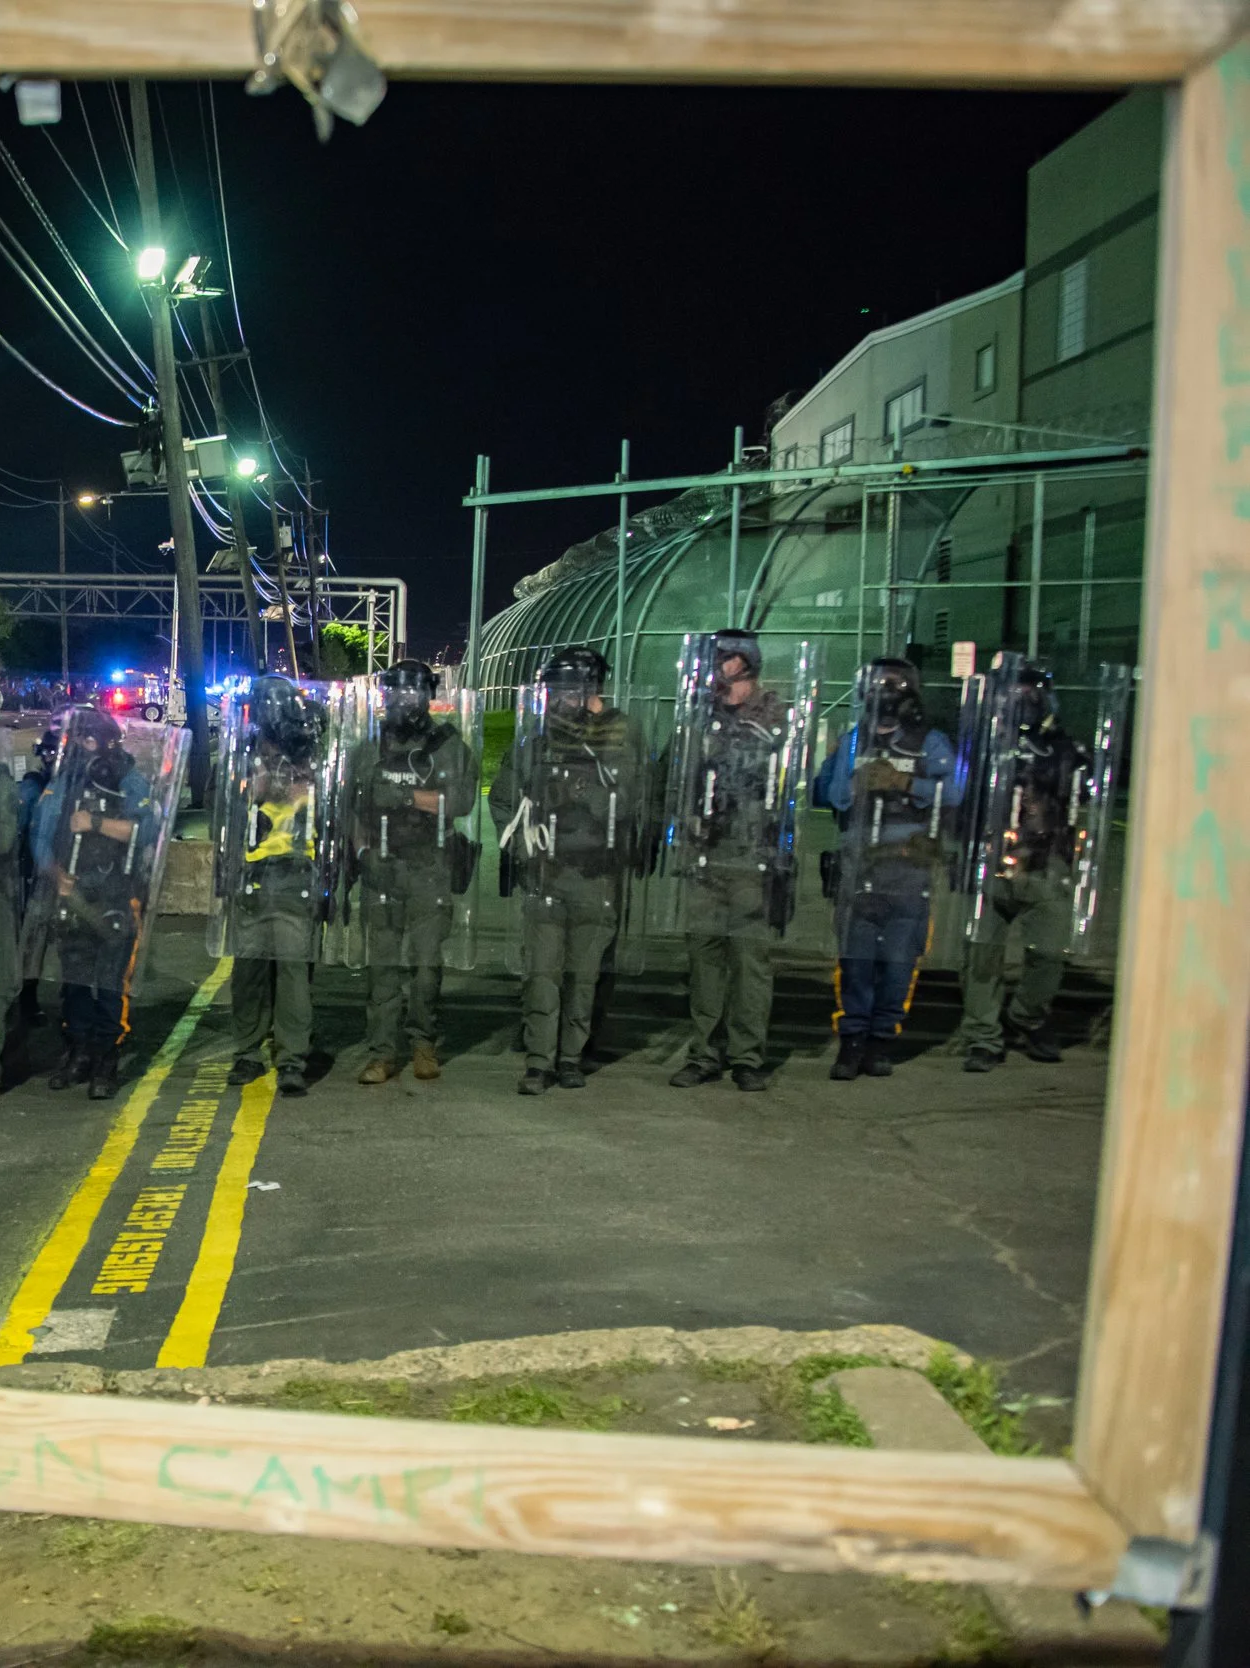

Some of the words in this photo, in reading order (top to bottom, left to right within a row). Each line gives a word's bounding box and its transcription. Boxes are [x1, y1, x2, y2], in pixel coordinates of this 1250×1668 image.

[162, 1099, 220, 1153] PROPERTY
[151, 1153, 198, 1169] NO
[90, 1183, 188, 1294] TRESPASSING
